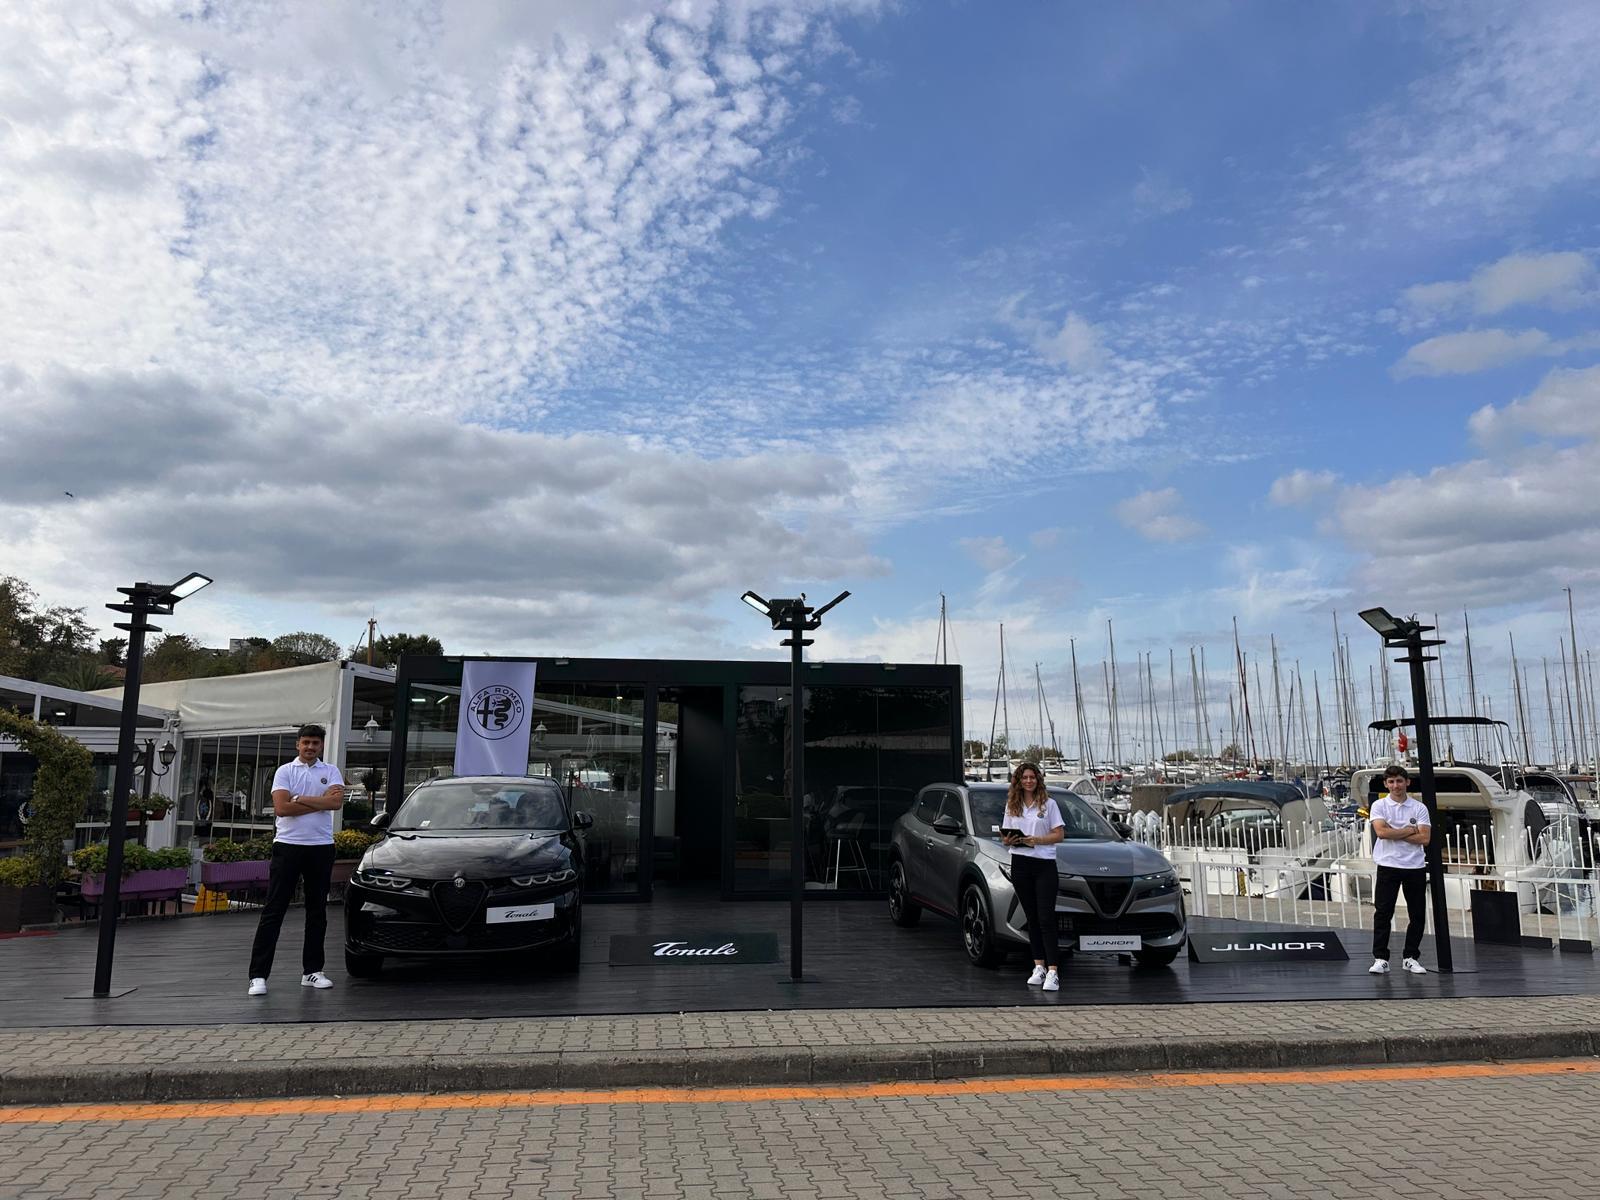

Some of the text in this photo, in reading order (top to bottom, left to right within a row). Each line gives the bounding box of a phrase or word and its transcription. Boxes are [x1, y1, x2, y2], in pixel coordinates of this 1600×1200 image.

[470, 687, 522, 713] ALFA ROMEO
[505, 909, 539, 919] Tonale
[652, 941, 739, 956] Tonale
[1211, 942, 1326, 952] JUNIOR
